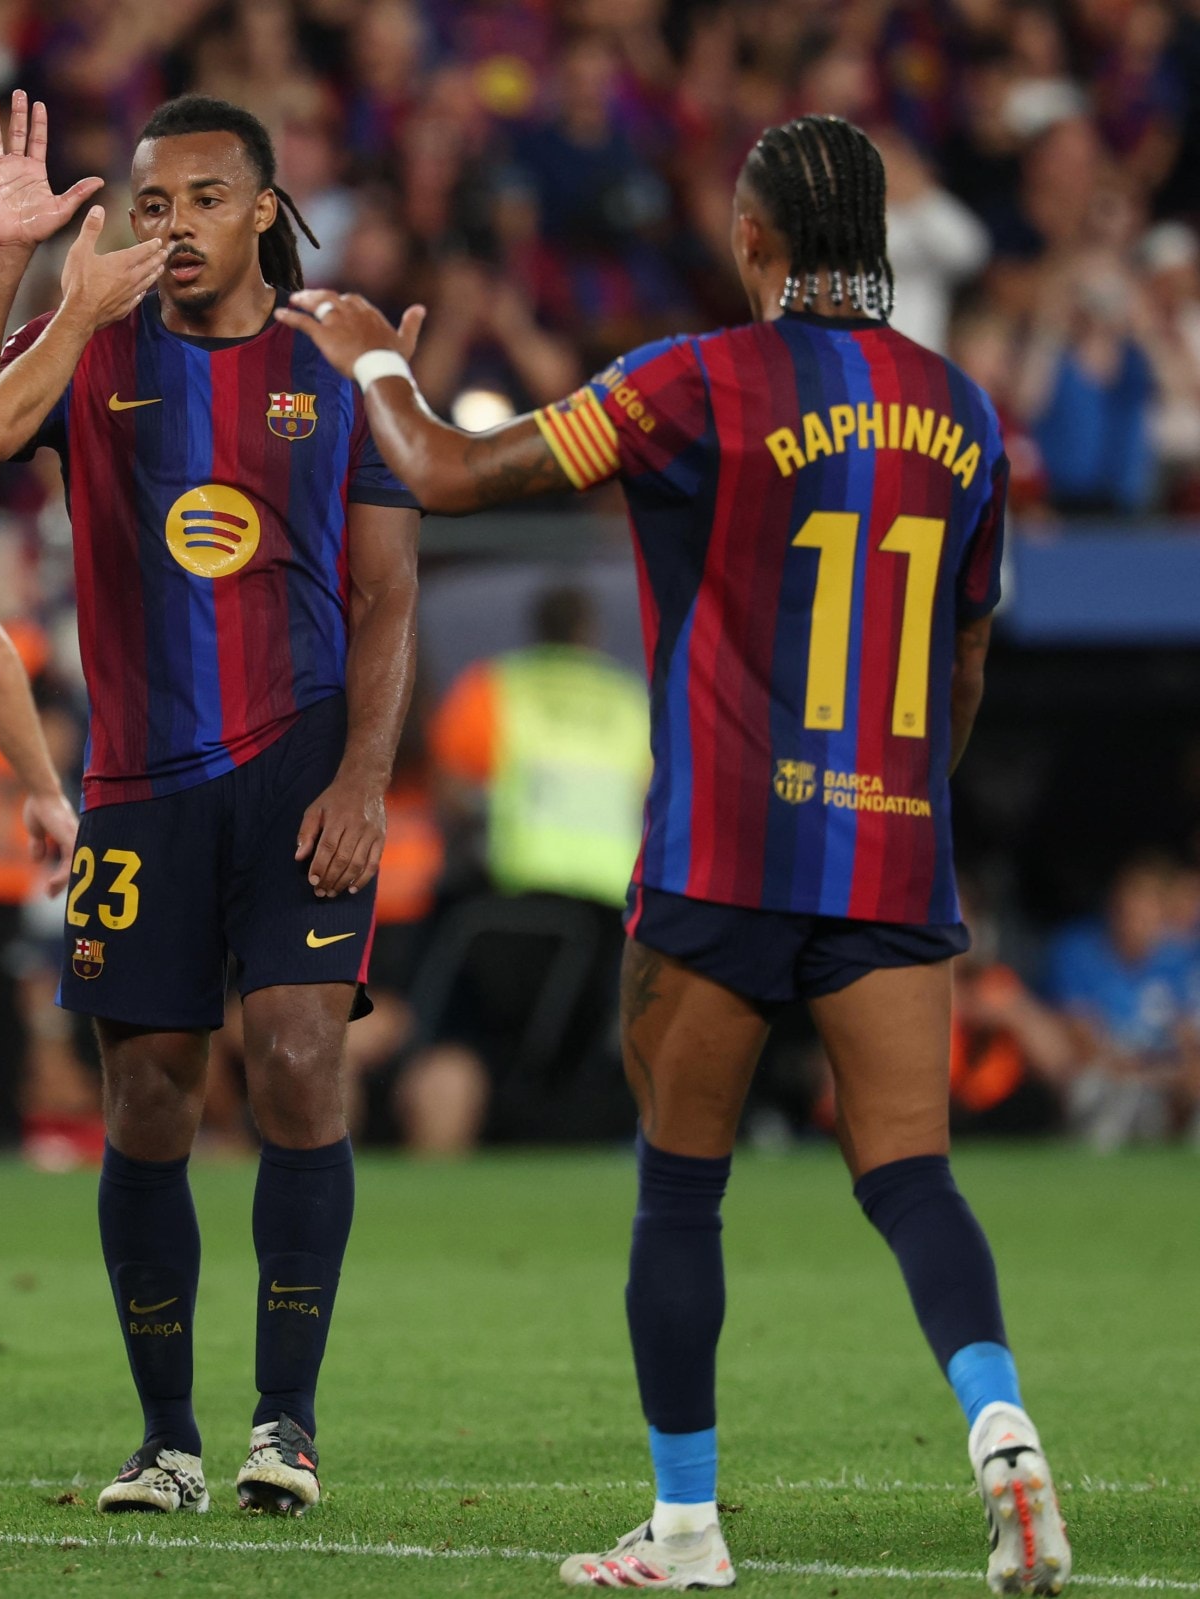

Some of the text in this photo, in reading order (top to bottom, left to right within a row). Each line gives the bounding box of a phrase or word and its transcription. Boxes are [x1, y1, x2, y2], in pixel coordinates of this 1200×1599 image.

[765, 402, 981, 490] RAPHINHA
[791, 510, 946, 738] 11
[823, 769, 884, 794] BARÇA
[823, 789, 932, 817] FOUNDATION
[67, 846, 142, 930] 23
[267, 1300, 320, 1318] BARÇA
[129, 1321, 183, 1337] BARÇA
